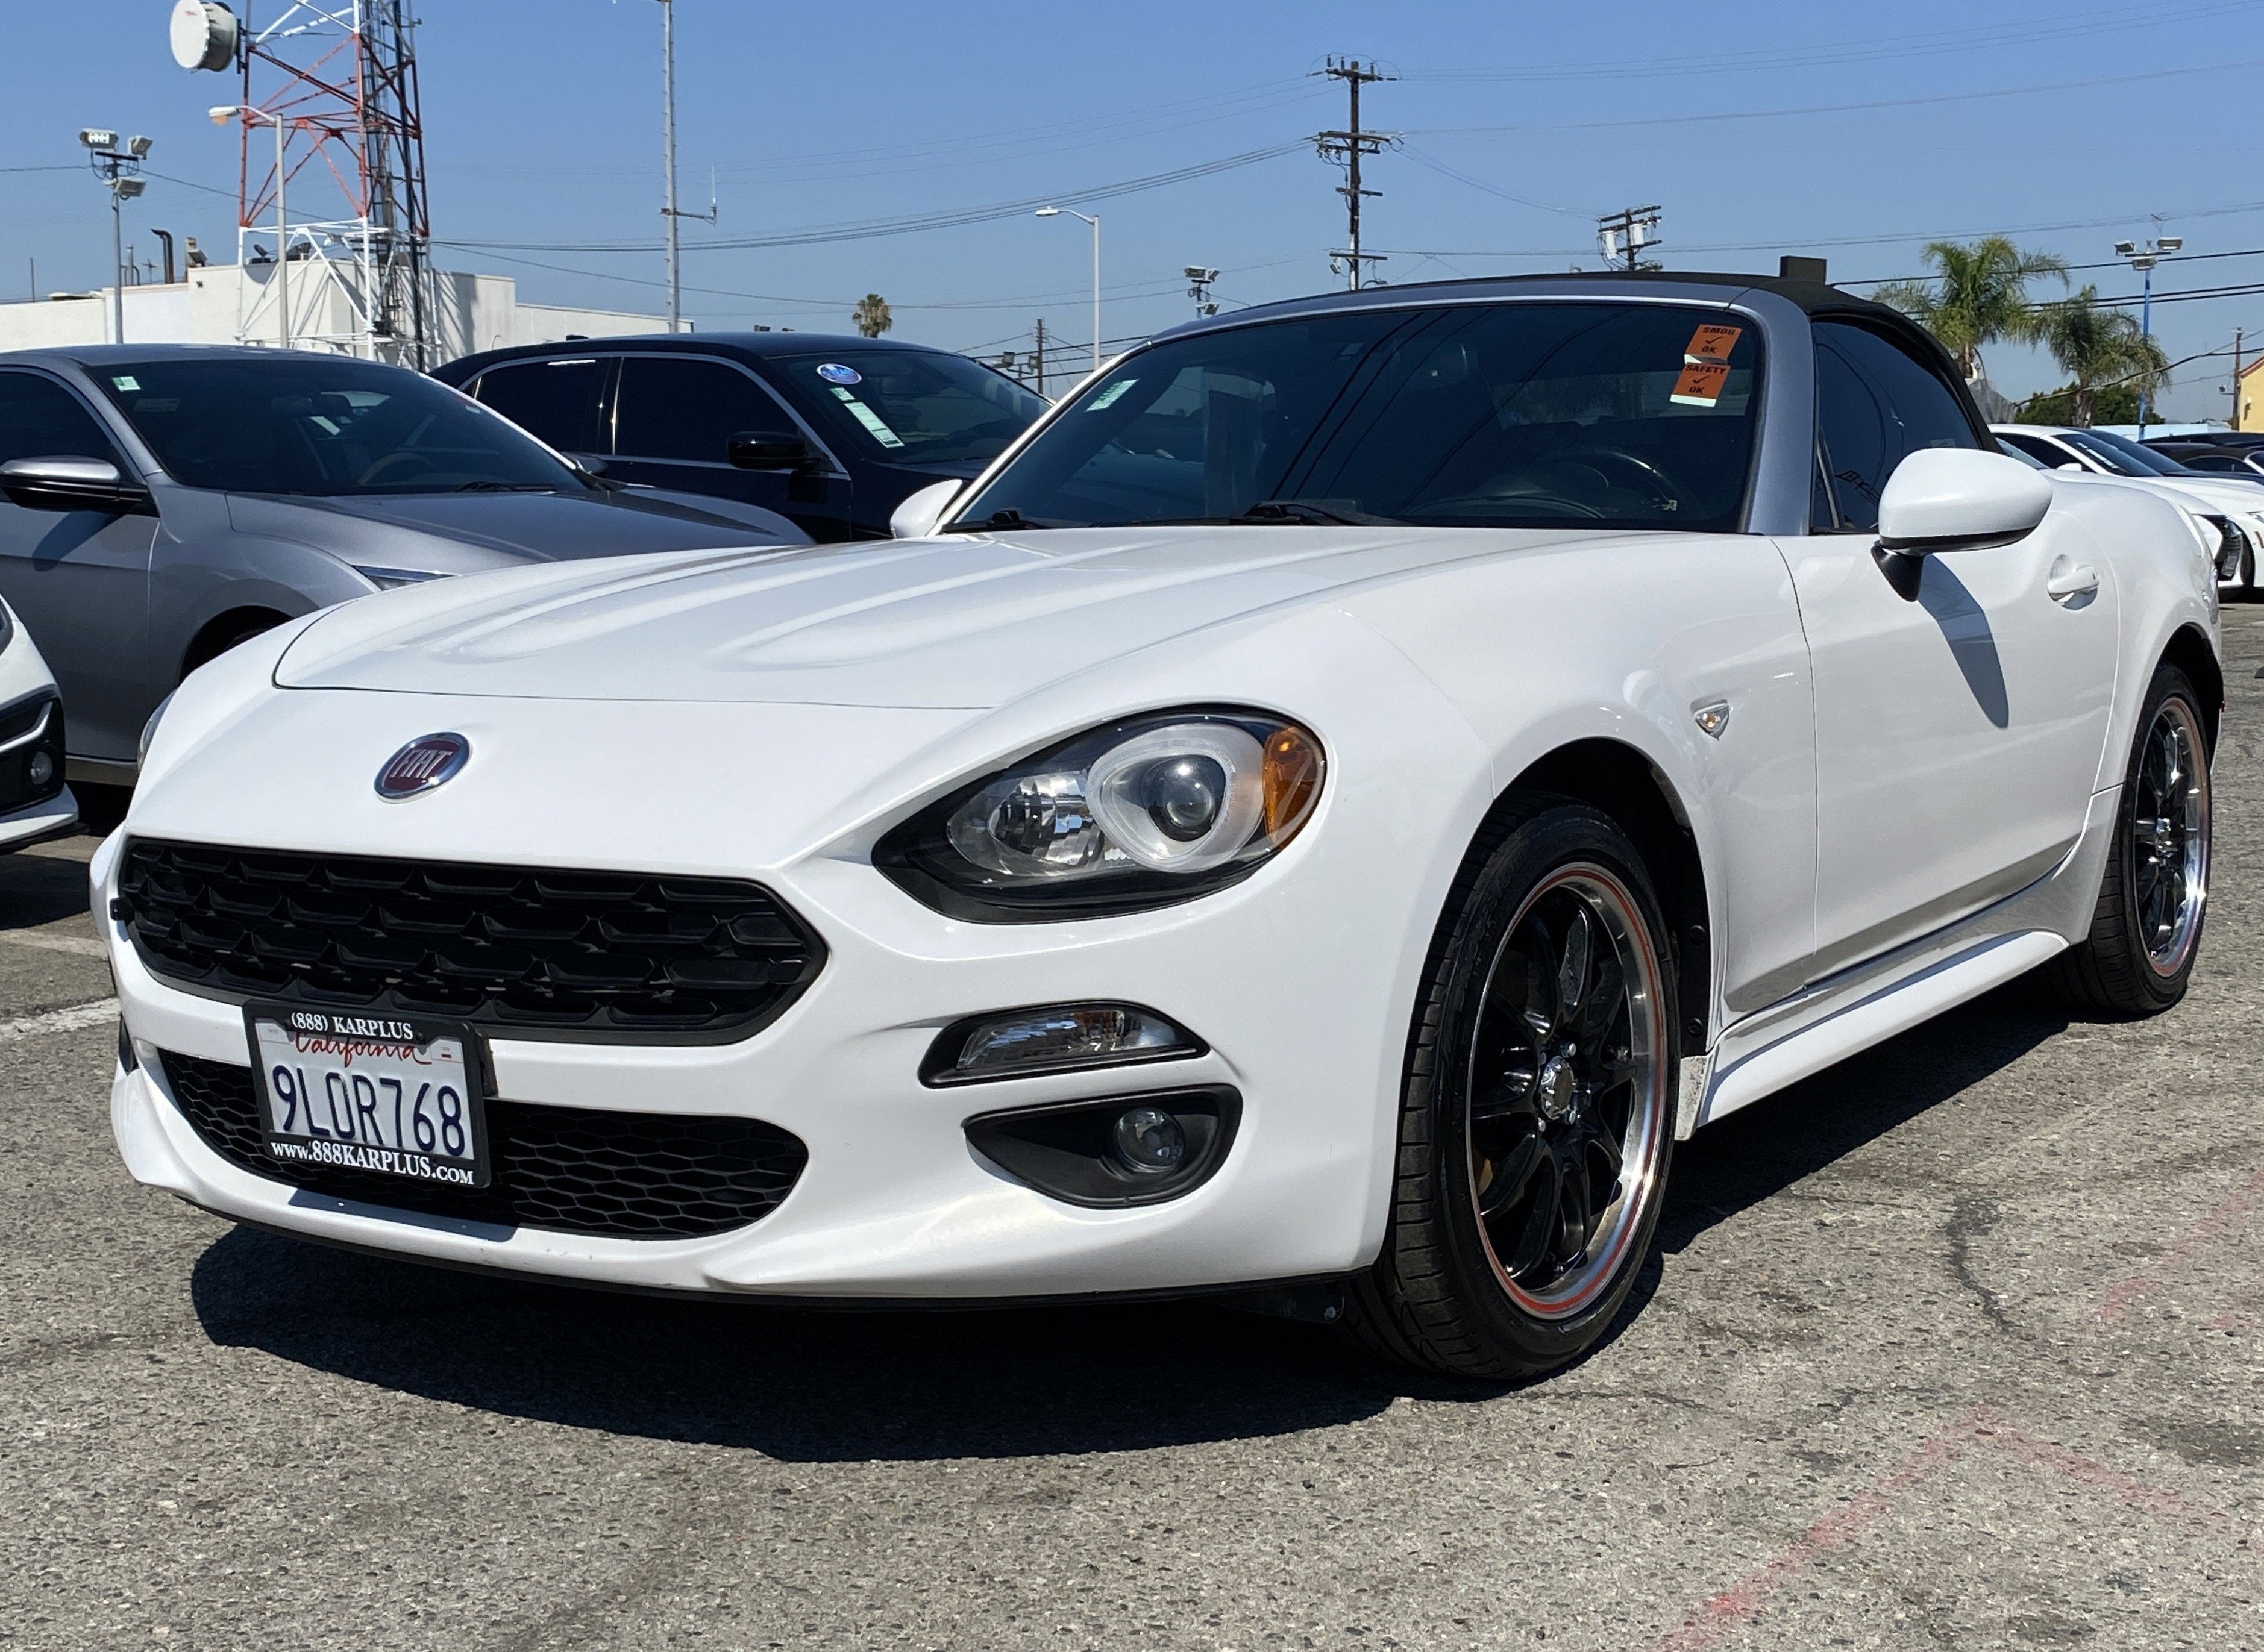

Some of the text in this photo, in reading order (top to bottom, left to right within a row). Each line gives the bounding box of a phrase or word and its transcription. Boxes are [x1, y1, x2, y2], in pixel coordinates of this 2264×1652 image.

[1685, 365, 1726, 375] SAFETY
[1689, 386, 1705, 395] OK
[389, 748, 453, 779] FIAT
[291, 1012, 413, 1040] (888) KARPLUS
[272, 1065, 465, 1156] 9LOR768
